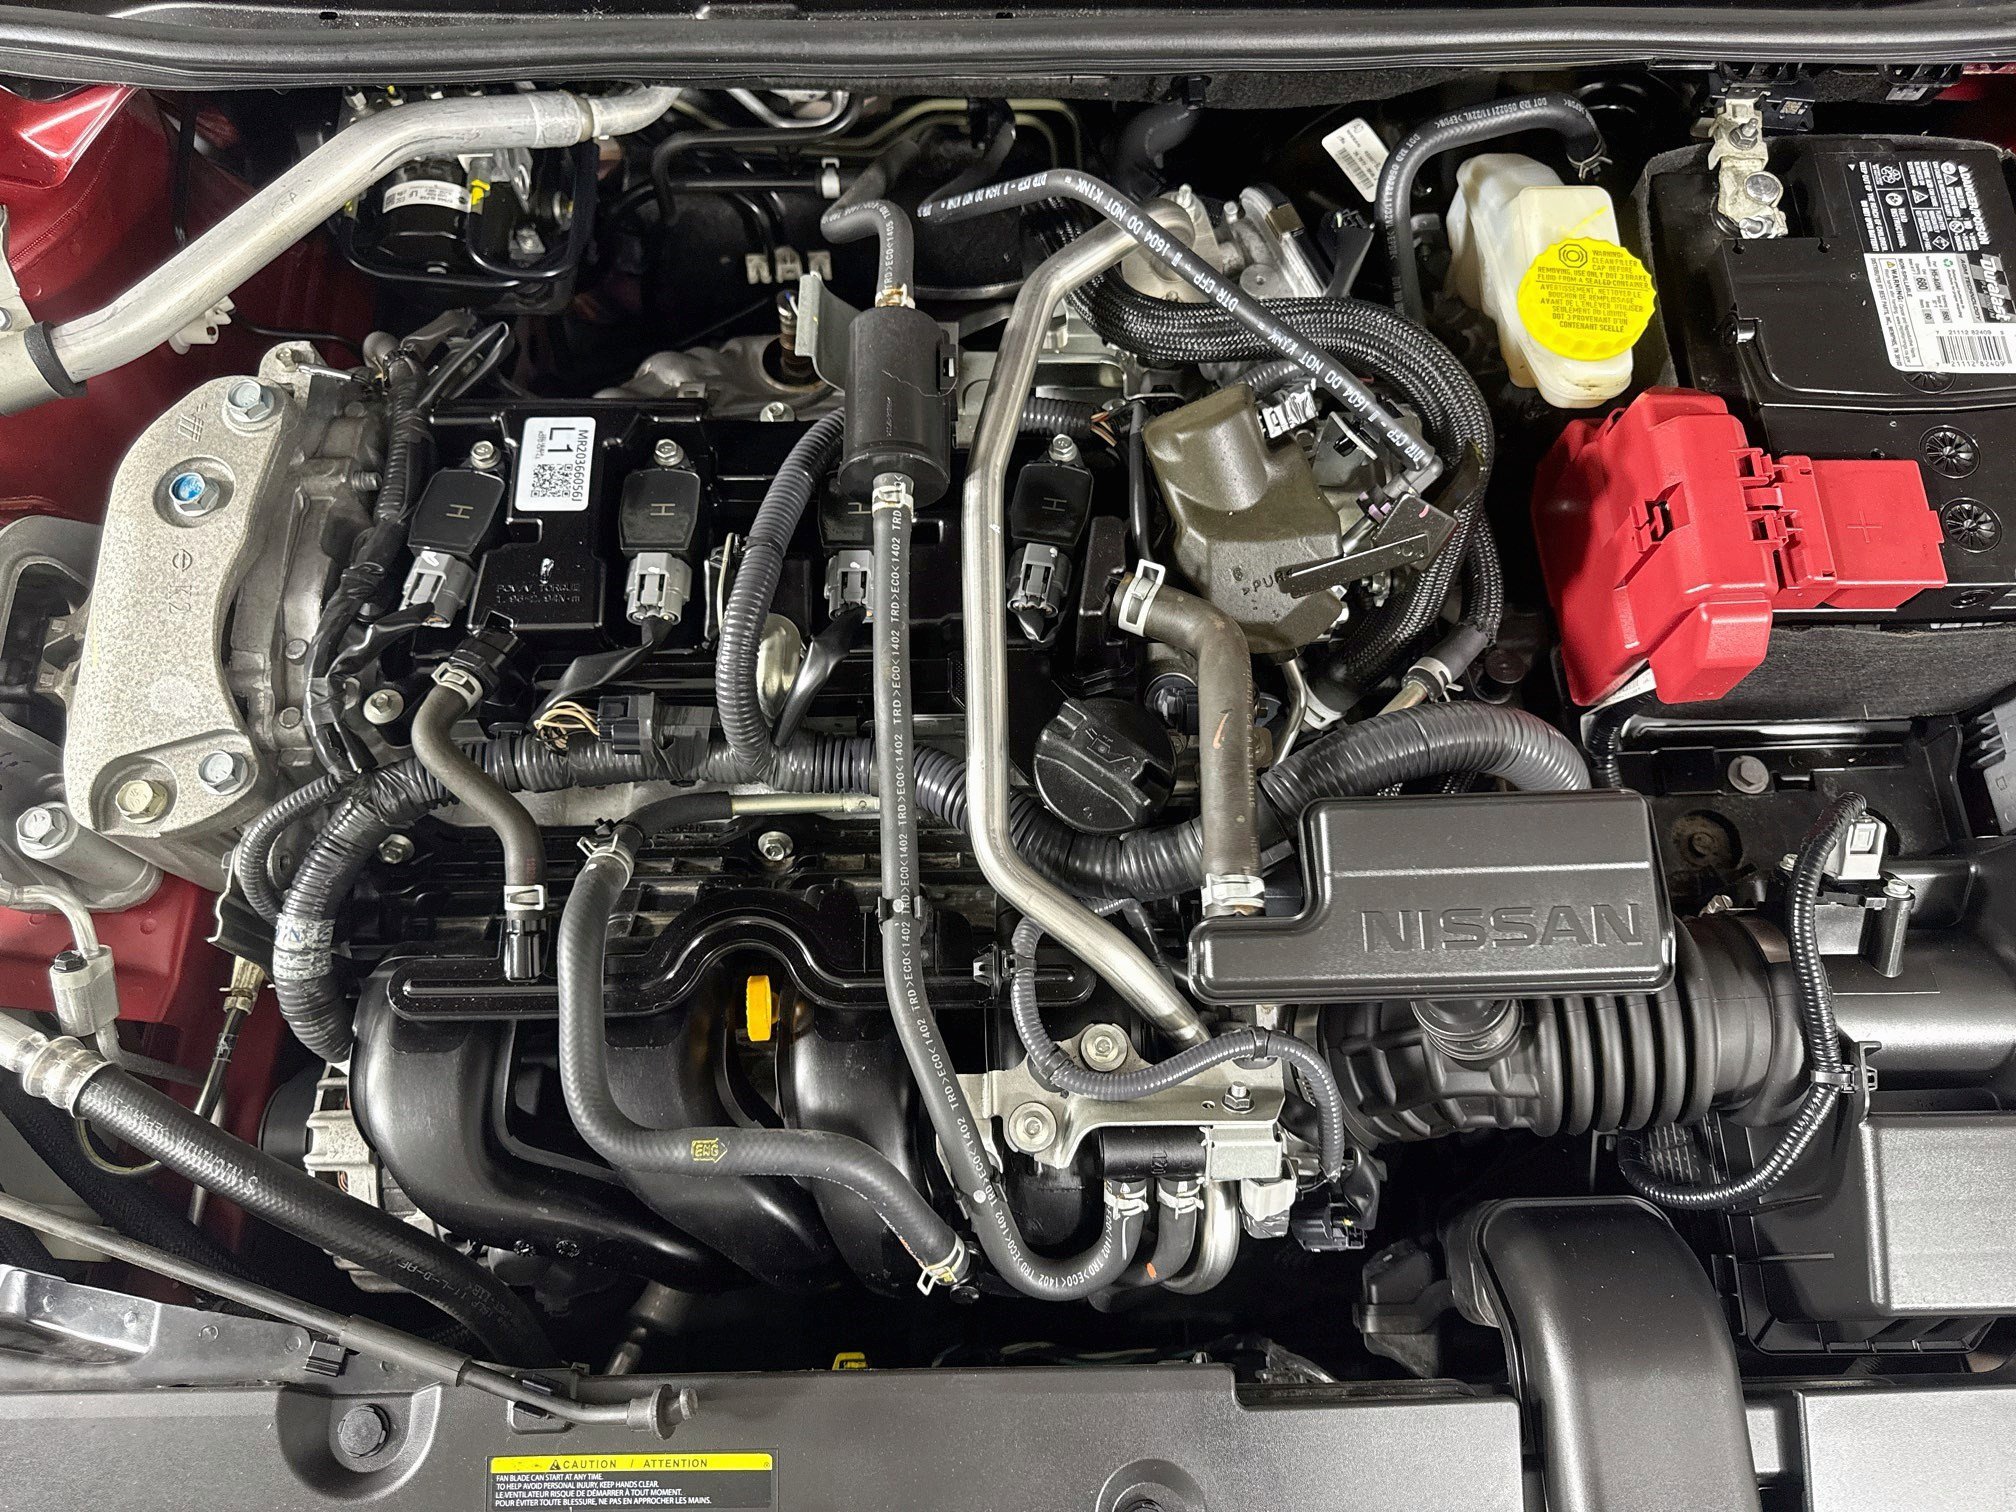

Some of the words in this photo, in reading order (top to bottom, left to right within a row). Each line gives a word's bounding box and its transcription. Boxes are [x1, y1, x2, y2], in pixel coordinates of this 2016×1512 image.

[1534, 97, 1547, 107] DOT
[1076, 178, 1104, 203] KINK
[1104, 200, 1127, 221] NOT
[1127, 215, 1143, 235] DO
[1144, 229, 1170, 256] 1604
[1193, 272, 1216, 294] CFP
[1538, 267, 1572, 276] REMOVING,
[1625, 274, 1647, 282] BRAKE
[1915, 277, 1928, 290] 680
[1216, 287, 1239, 312] DTR
[1980, 257, 2011, 322] Duralast
[1298, 350, 1324, 374] NOT
[1324, 369, 1344, 389] DO
[1342, 385, 1370, 412] 1604
[1386, 430, 1410, 446] CFP
[572, 430, 589, 502] MR20366056J
[1404, 443, 1425, 463] DTR
[891, 536, 901, 623] TRD>ECO<1402
[890, 629, 902, 725] TRD>ECO<1402
[894, 734, 907, 826] TRD>ECO<1402
[899, 833, 911, 915] TRD>ECO<1402
[1362, 903, 1644, 952] NISSAN
[902, 922, 920, 1011] TRD>ECO<1402
[917, 1018, 959, 1111] TRD>ECO<1402
[695, 1144, 719, 1157] ENG
[957, 1116, 999, 1207] TRD>ECO<1402
[995, 1209, 1035, 1281] TRD>ECO<1402
[1038, 1259, 1104, 1288] TRD>ECO<1402
[563, 1460, 616, 1468] CAUTION
[643, 1459, 708, 1468] ATTENTION
